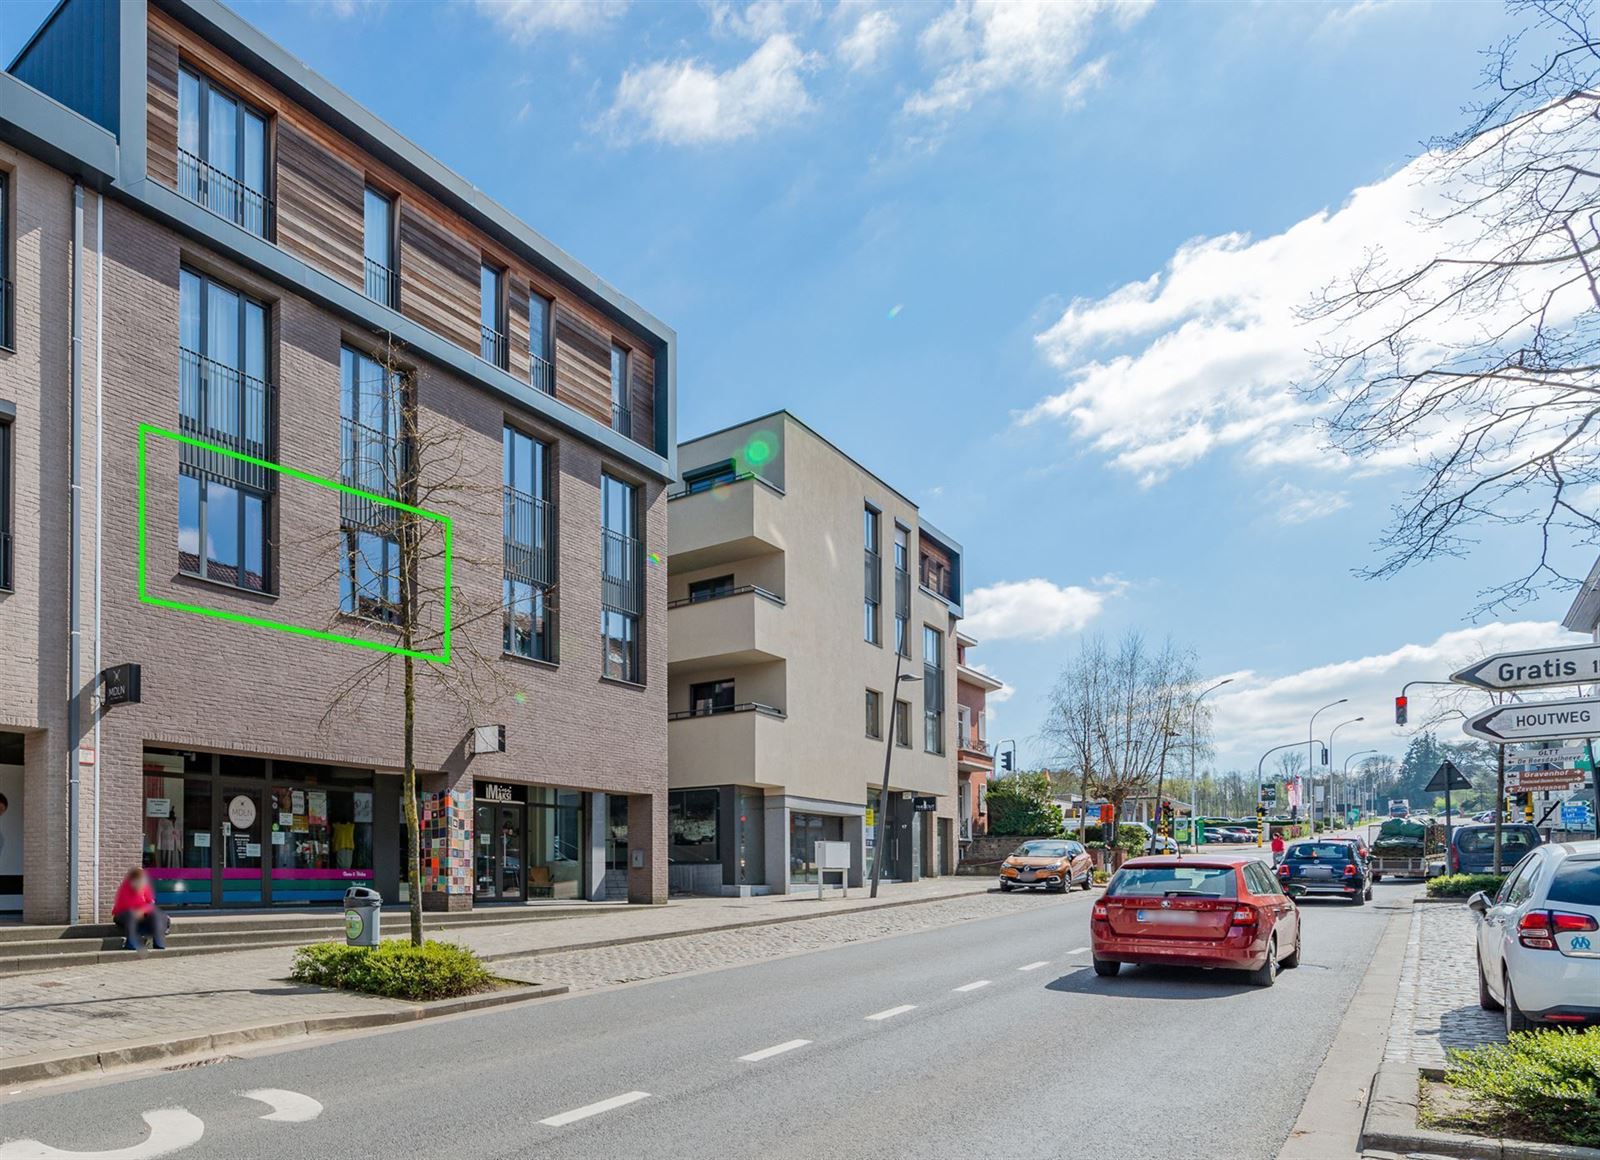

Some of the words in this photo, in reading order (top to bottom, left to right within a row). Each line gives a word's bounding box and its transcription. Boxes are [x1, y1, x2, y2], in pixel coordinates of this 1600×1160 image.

[1498, 658, 1577, 682] Gratis
[1516, 710, 1591, 727] HOUTWEG
[1524, 769, 1569, 778] Gravenhof
